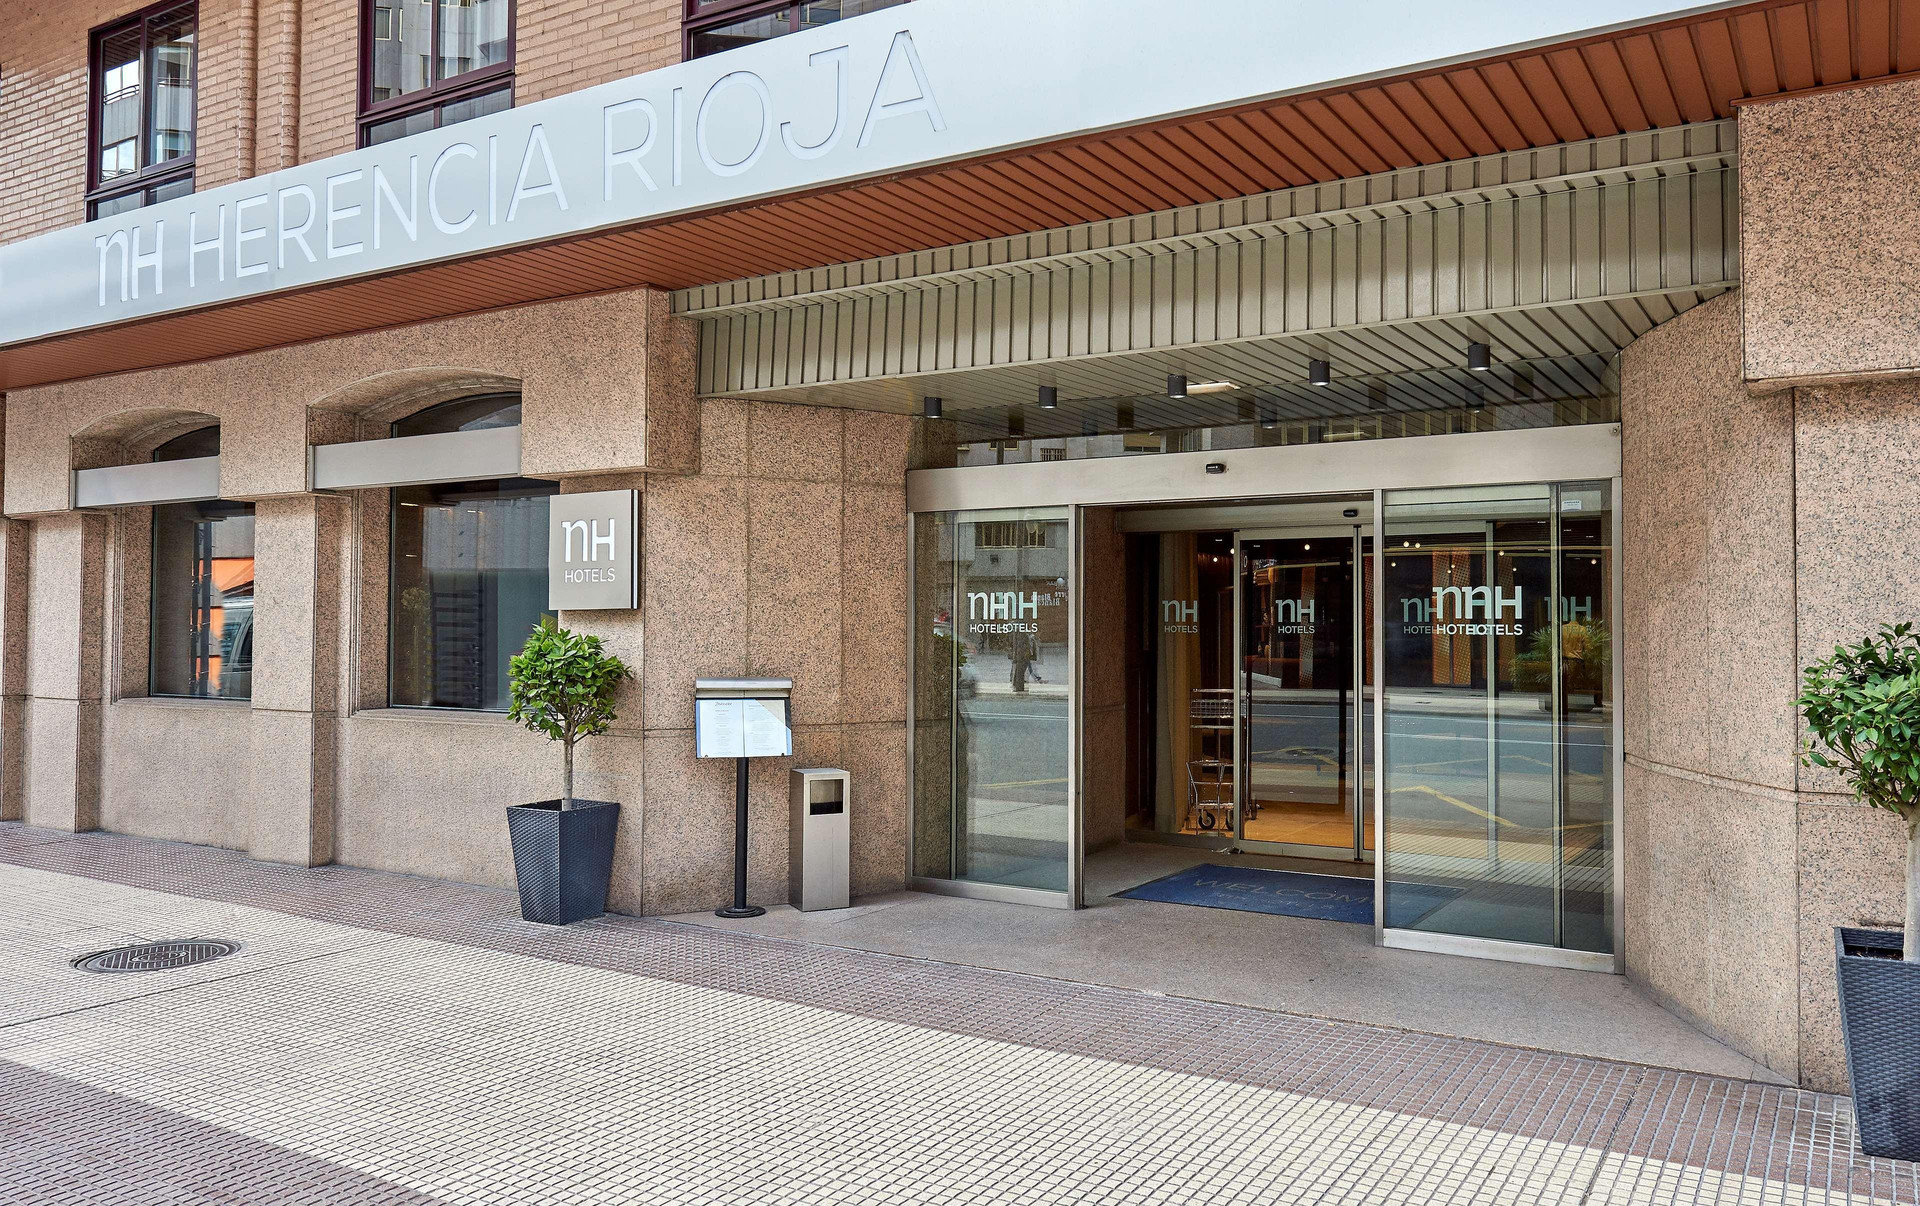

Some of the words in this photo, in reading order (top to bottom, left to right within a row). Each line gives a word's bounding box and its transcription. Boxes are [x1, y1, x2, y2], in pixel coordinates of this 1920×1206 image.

[188, 123, 570, 287] HERENCIA
[602, 29, 948, 202] RIOJA
[561, 517, 616, 563] nH
[564, 567, 616, 583] HOTELS
[1164, 625, 1199, 634] HOTELS
[1277, 625, 1315, 634] HOTELS
